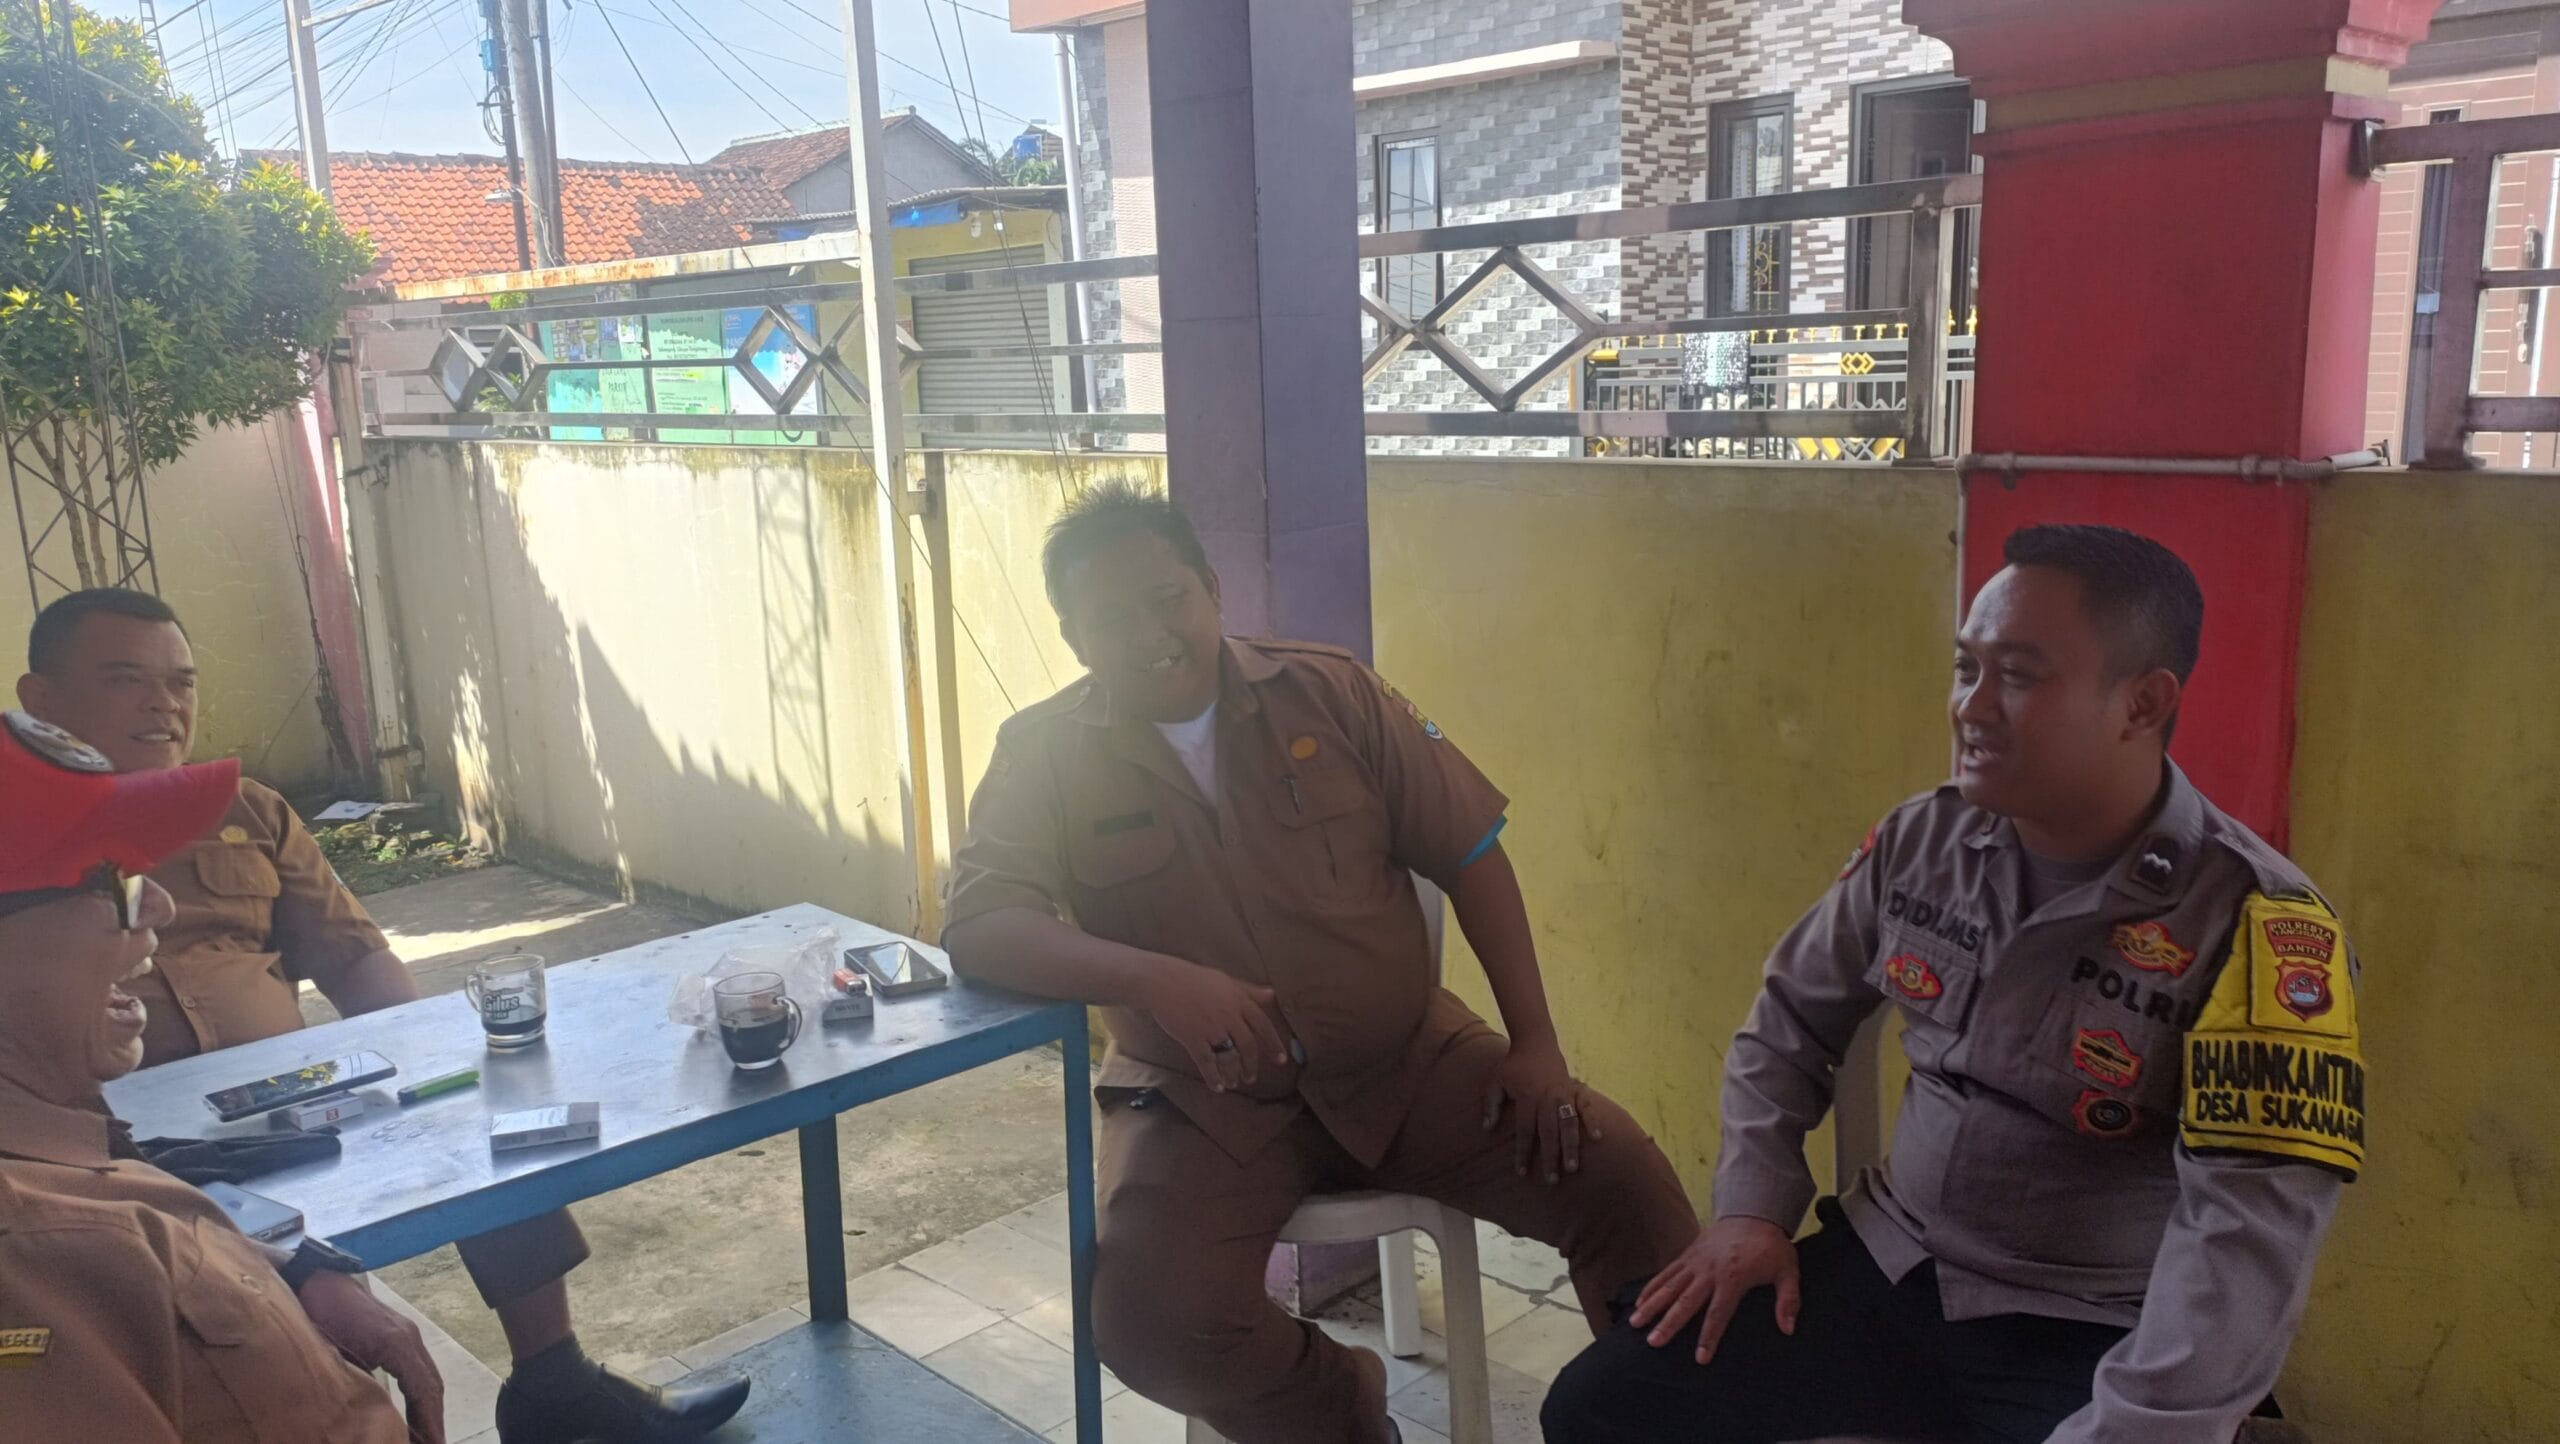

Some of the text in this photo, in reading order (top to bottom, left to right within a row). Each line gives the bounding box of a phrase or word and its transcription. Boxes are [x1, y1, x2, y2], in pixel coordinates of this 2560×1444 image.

[2270, 920, 2332, 940] POLRESTA
[2278, 943, 2328, 959] BANTEN
[2070, 956, 2190, 1026] POLRI
[482, 993, 520, 1013] Gilus
[2196, 1091, 2249, 1124] DESA
